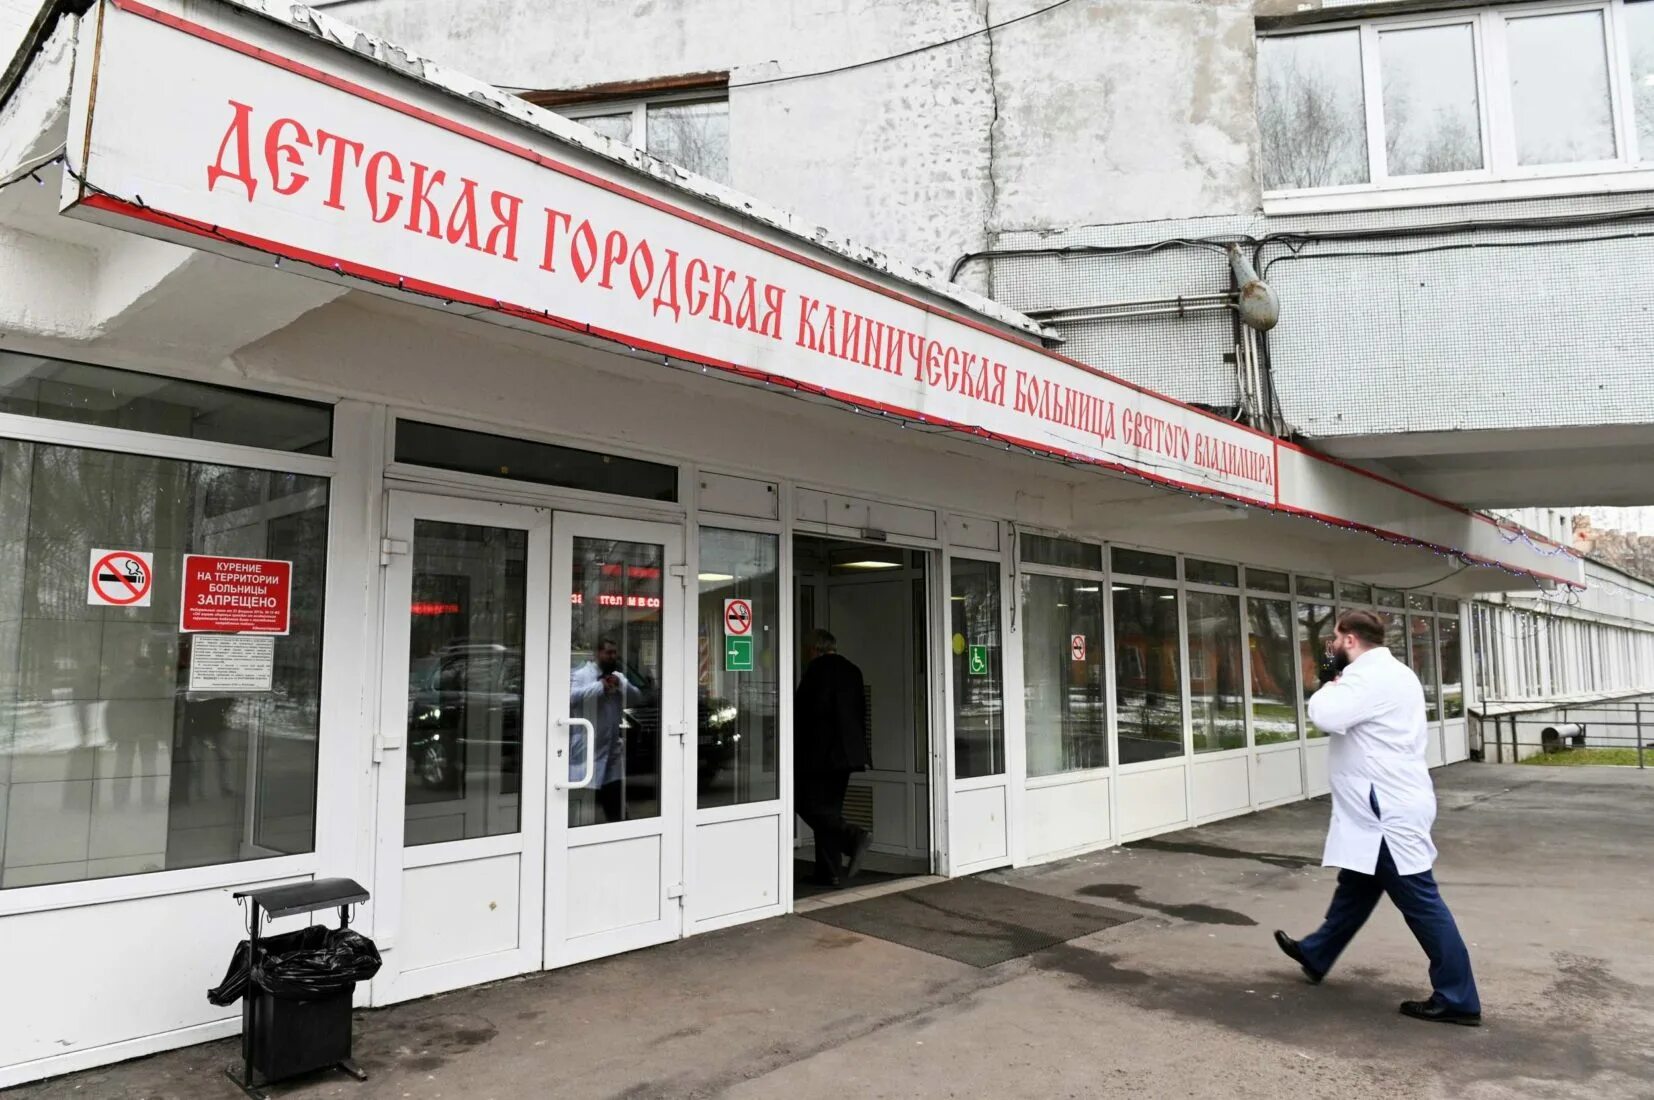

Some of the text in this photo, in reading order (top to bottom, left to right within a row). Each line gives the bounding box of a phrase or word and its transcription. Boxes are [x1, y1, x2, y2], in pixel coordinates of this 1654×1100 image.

[207, 100, 1273, 486] ДЕТСКАЯ ГОРОДСКАЯ КЛИНИЧЕСКАЯ БОЛЬНИЦА СВЯТОГО ВЛАДИМИРА
[216, 562, 262, 573] КУРЕНИЕ
[197, 572, 279, 585] НА ТЕРРИТОРИИ
[209, 583, 267, 596] БОЛЬНИЦЫ
[197, 594, 277, 609] ЗАПРЕЩЕНО
